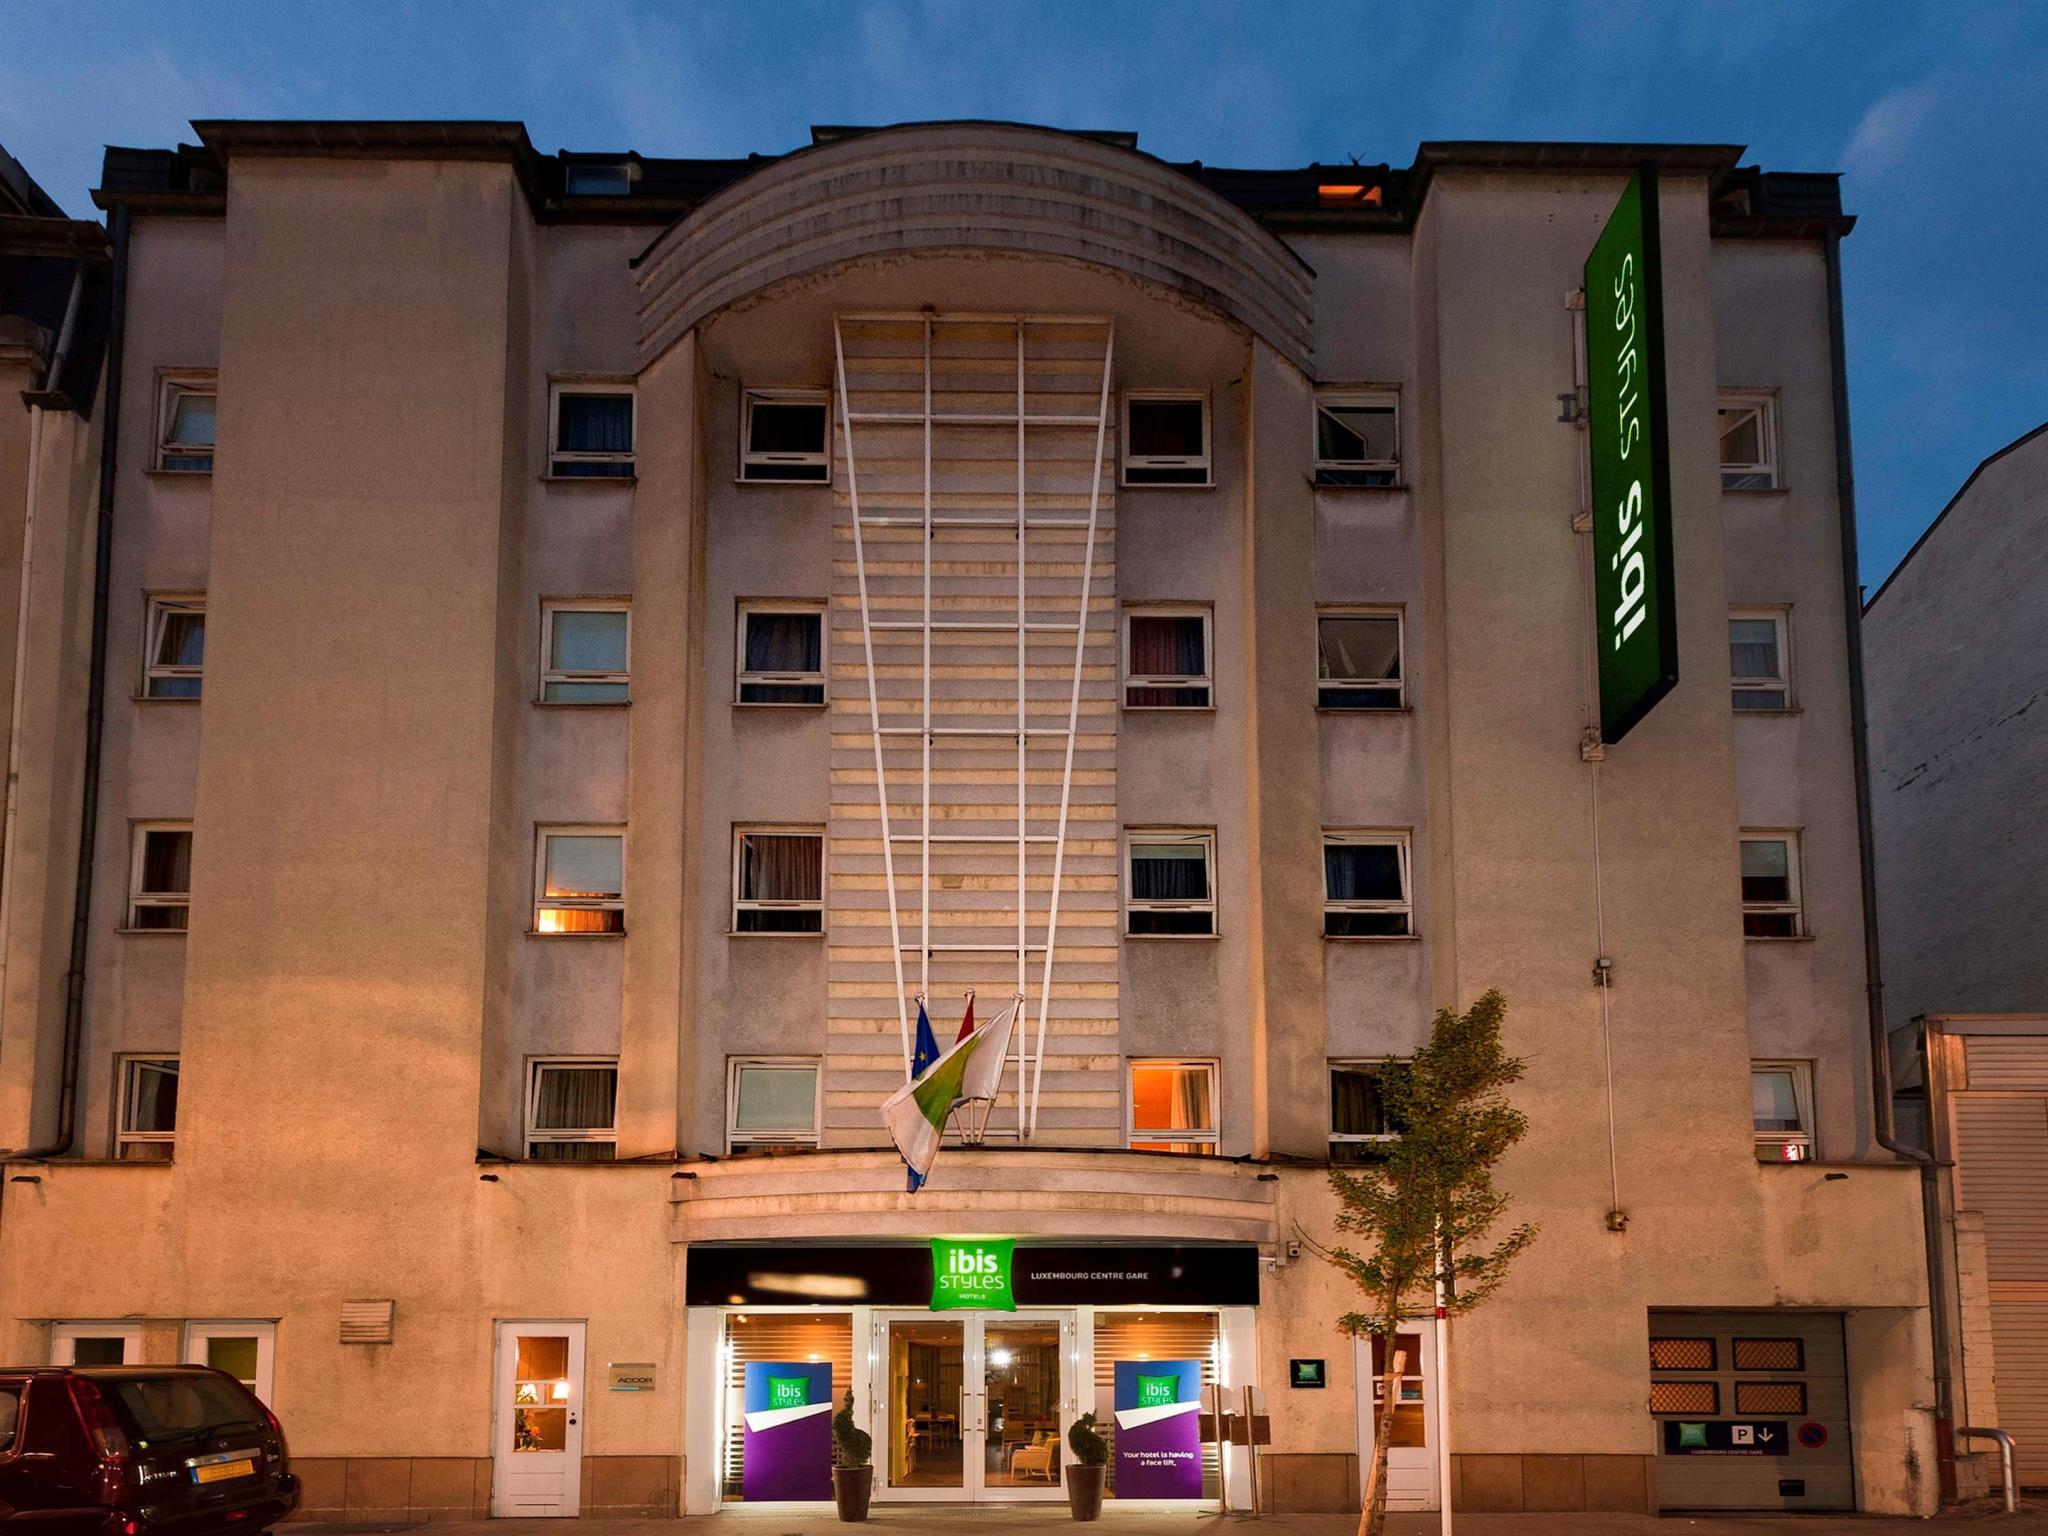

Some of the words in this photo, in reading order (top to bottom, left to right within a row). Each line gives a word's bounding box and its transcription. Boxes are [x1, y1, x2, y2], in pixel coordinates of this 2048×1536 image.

[1612, 480, 1646, 651] ibis
[949, 1248, 998, 1274] ibis
[1031, 1272, 1089, 1280] LUXEMBOURG
[1090, 1272, 1124, 1280] CENTRE
[1126, 1272, 1149, 1280] GARE
[777, 1384, 801, 1397] ibis
[1146, 1382, 1170, 1396] ibis
[1738, 1429, 1748, 1441] P
[1169, 1451, 1194, 1459] having
